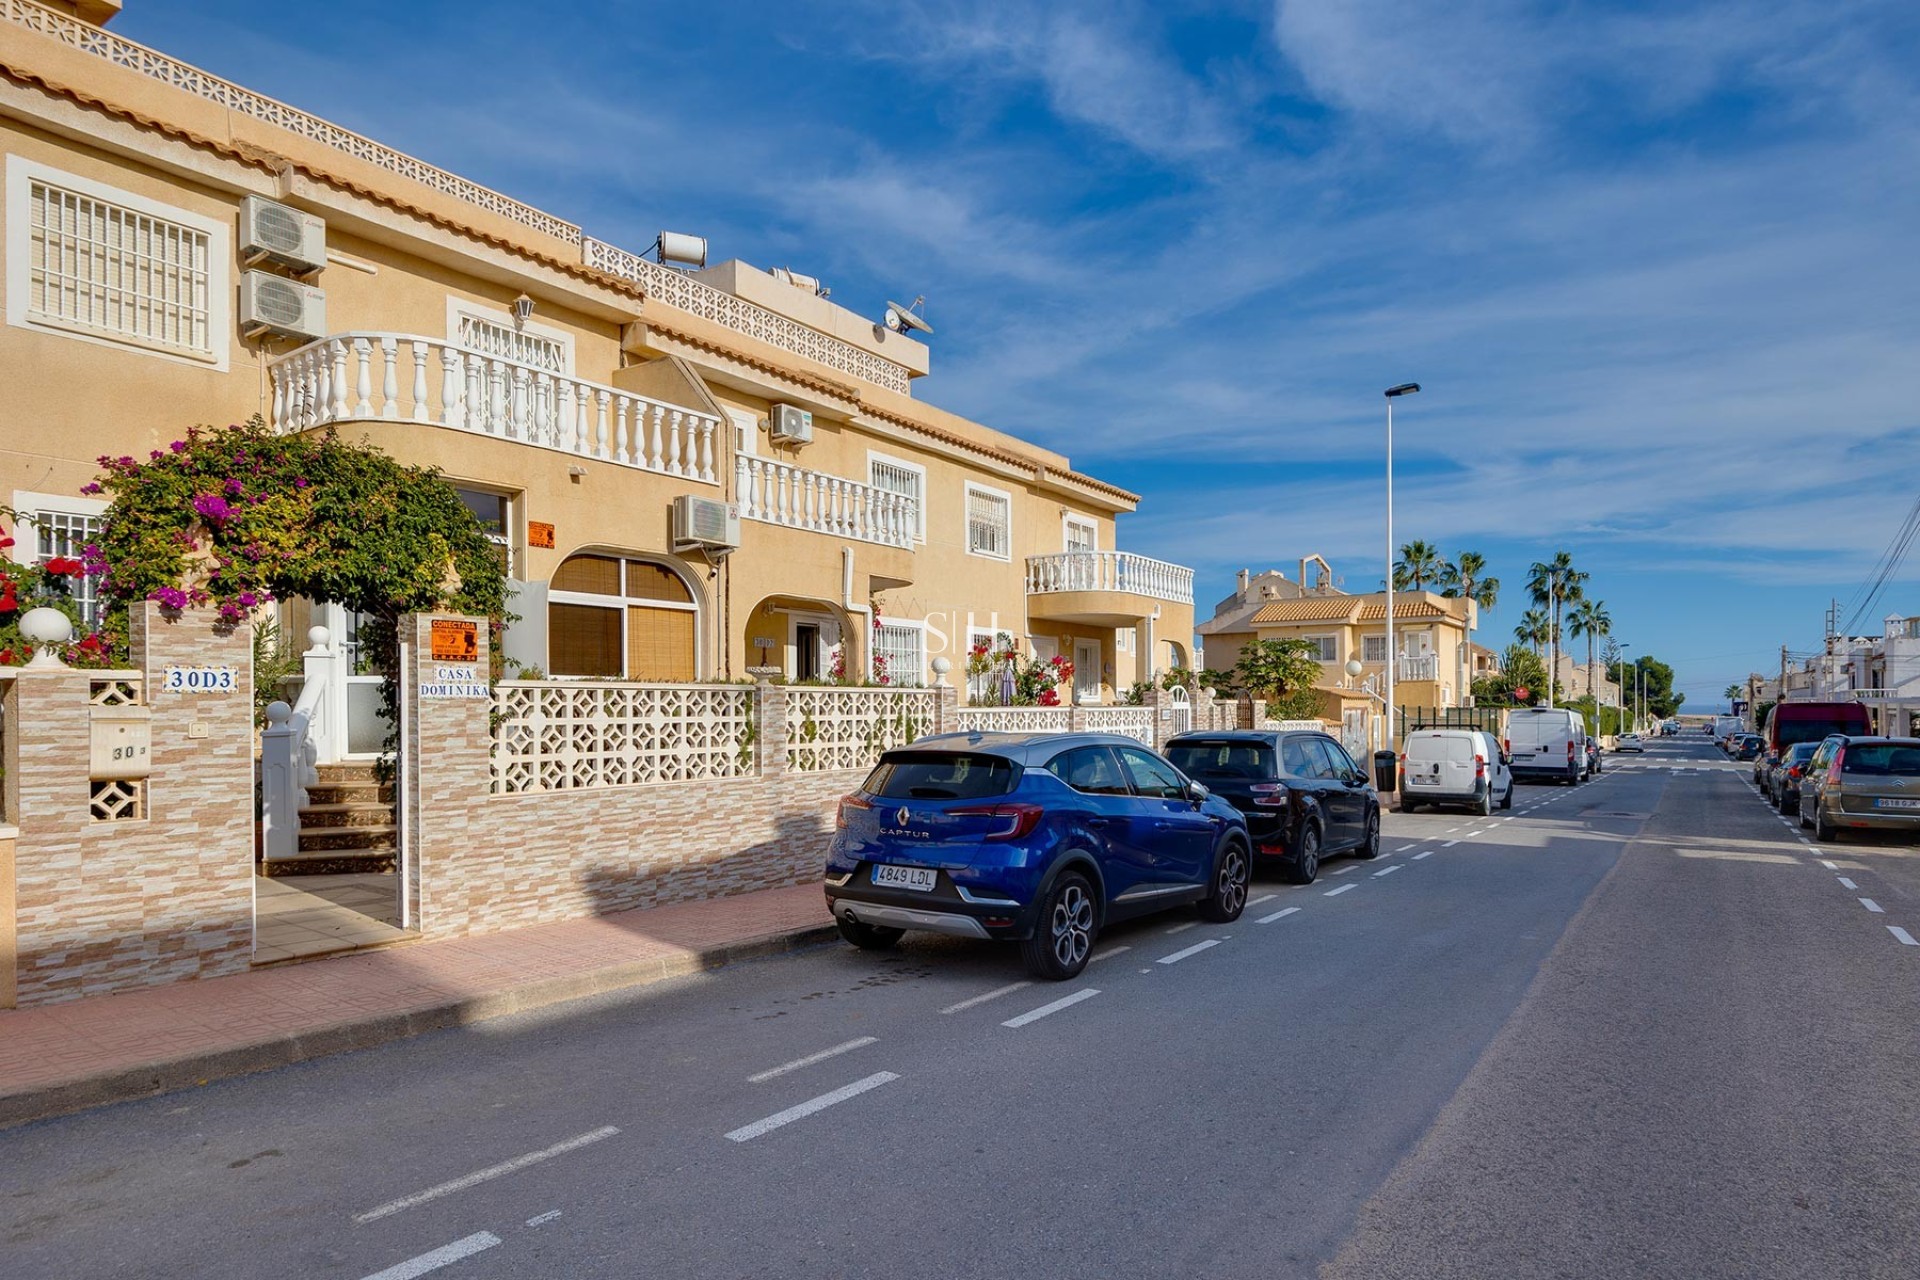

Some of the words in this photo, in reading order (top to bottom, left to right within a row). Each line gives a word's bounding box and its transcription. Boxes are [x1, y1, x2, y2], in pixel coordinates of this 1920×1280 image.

[432, 620, 475, 629] CONECTADA
[171, 671, 231, 688] 30D3
[438, 668, 472, 679] CASA
[421, 685, 489, 696] DOMINIKA
[112, 746, 134, 761] 30
[879, 827, 930, 839] CAPTUR
[879, 867, 908, 882] 4849
